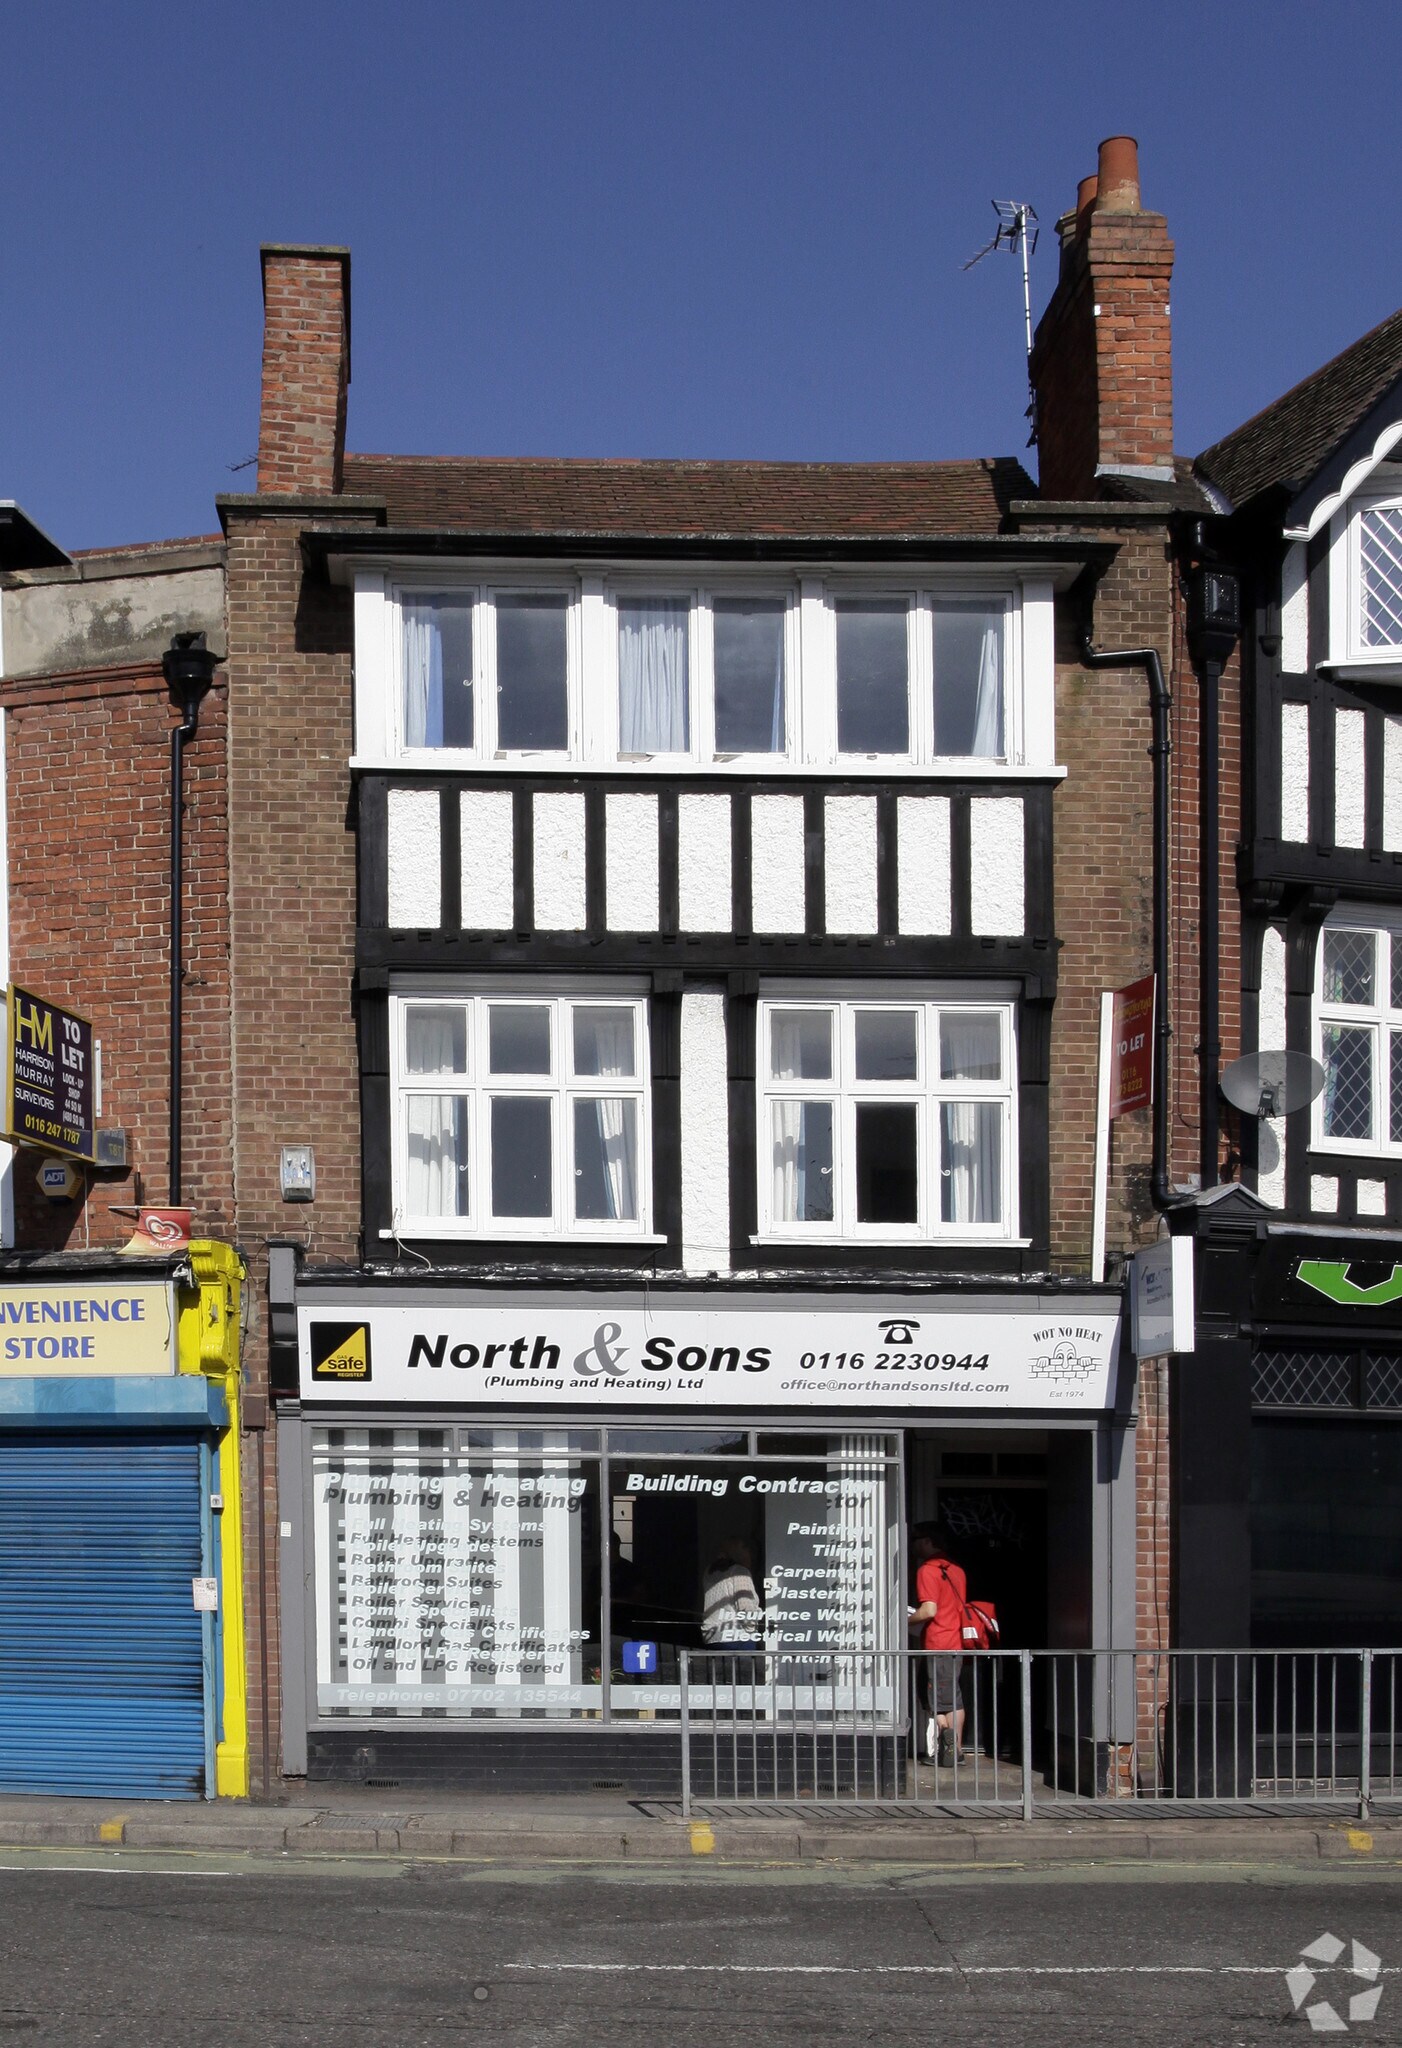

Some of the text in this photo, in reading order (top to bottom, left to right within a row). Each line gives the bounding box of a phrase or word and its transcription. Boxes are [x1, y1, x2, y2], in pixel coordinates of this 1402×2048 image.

[15, 997, 54, 1056] HM
[62, 1017, 81, 1044] TO
[1116, 1032, 1145, 1057] TO LET
[15, 1046, 54, 1072] HARRISON
[61, 1043, 84, 1072] LET
[15, 1063, 55, 1088] MURRAY
[1121, 1065, 1137, 1080] 0116
[15, 1087, 55, 1111] SURVEYORS
[67, 1086, 81, 1100] SHOP
[25, 1114, 81, 1145] 0116 247 1787
[45, 1172, 65, 1183] ADT
[0, 1298, 145, 1324] VENIENCE
[1032, 1327, 1103, 1343] WOT NO HEAT
[5, 1336, 95, 1360] STORE
[407, 1322, 772, 1377] North & Sons
[328, 1357, 363, 1370] safe
[799, 1352, 990, 1371] 0116 2230944
[484, 1376, 703, 1391] (Plumbing and Heating) Ltd
[780, 1379, 1010, 1393] office@northandsonsltd.com
[1049, 1390, 1085, 1398] Est 1974
[325, 1473, 586, 1495] Plumbing & Heating
[626, 1474, 877, 1496] Building Contractor
[787, 1522, 863, 1541] Painting
[770, 1565, 863, 1580] Carpentry
[770, 1586, 863, 1603] Plastering
[718, 1608, 863, 1621] Insurance Work
[721, 1629, 863, 1642] Electrical Work
[337, 1688, 582, 1705] Telephone: 07702 135544
